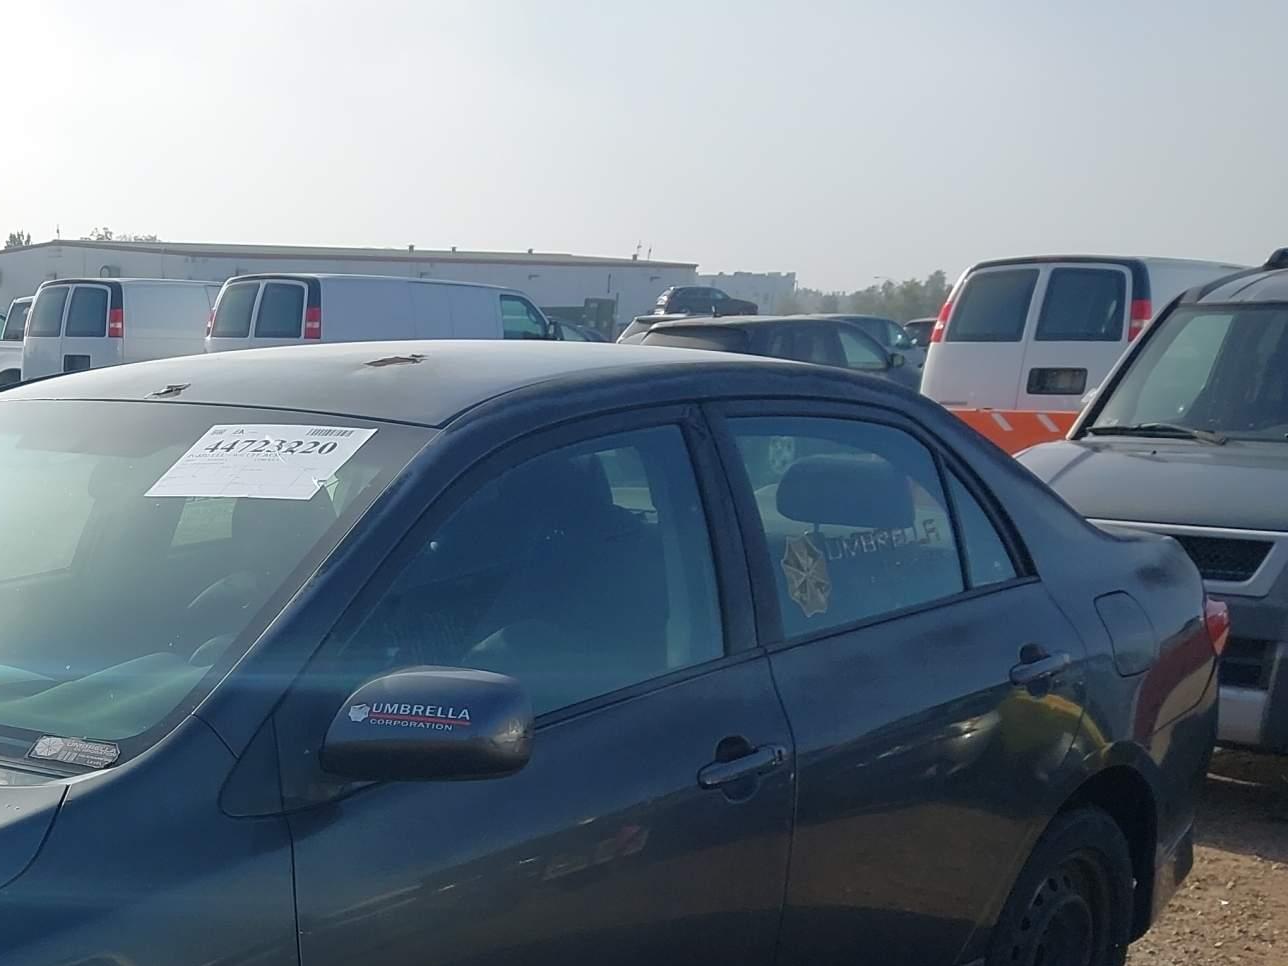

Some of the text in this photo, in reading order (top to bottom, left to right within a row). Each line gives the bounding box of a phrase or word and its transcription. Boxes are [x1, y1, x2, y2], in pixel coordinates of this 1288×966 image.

[204, 439, 339, 455] 44723220
[372, 703, 471, 720] UMBRELLA
[369, 718, 453, 731] CORPORATION
